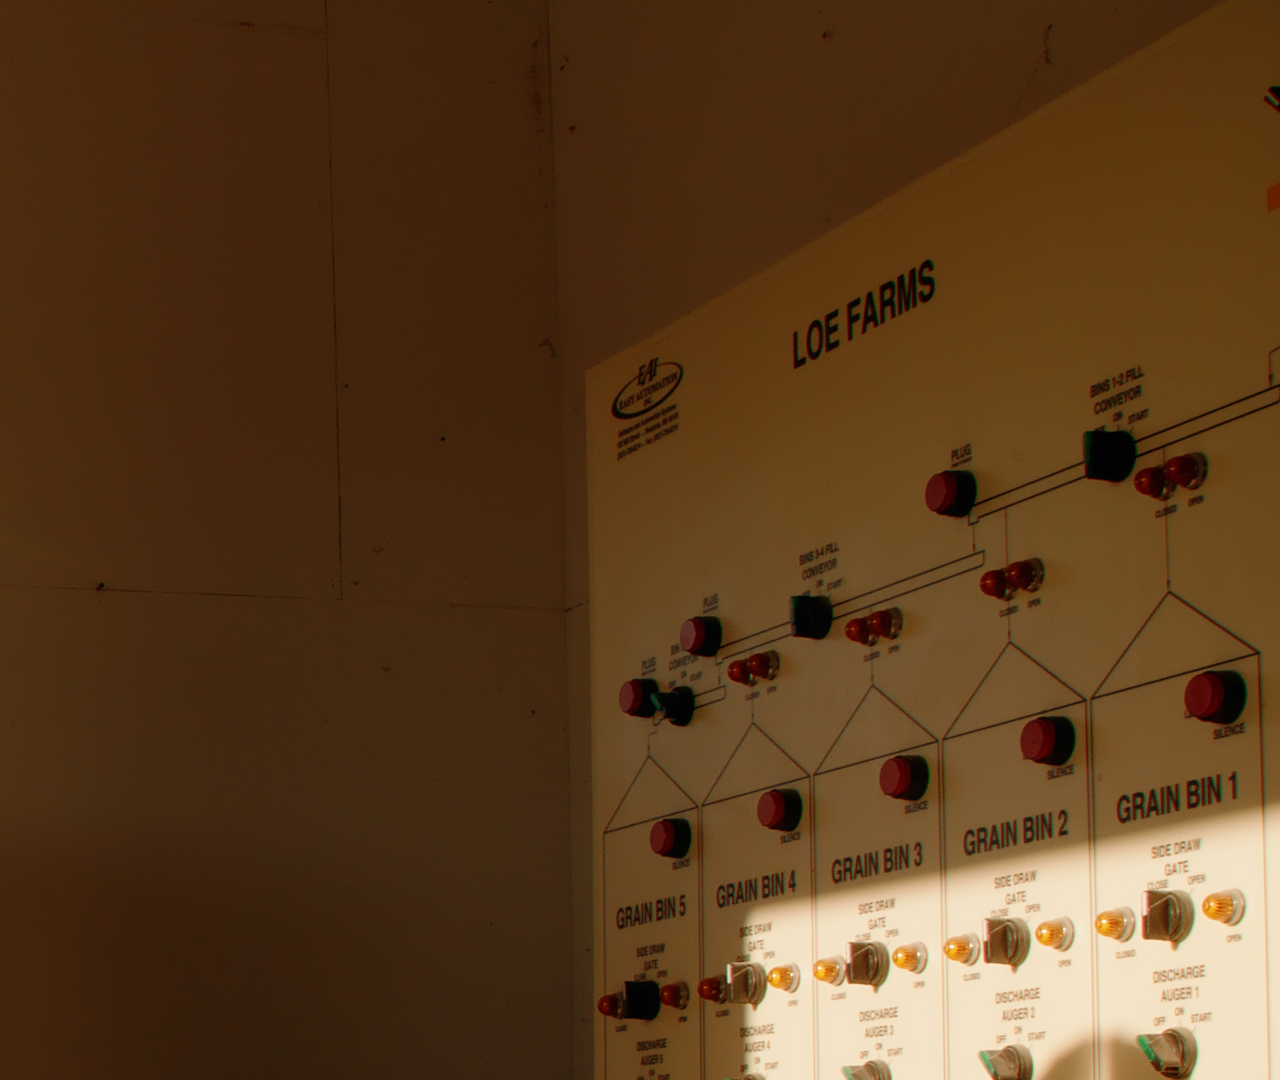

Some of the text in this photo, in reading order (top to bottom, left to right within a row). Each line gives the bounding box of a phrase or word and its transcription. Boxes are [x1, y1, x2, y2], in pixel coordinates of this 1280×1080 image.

[793, 259, 936, 370] LOE FARMS
[1090, 365, 1144, 398] BINS 1-2 FILL
[1094, 384, 1142, 414] CONVEYOR
[1128, 408, 1148, 425] START
[951, 444, 972, 462] PLUG
[1188, 494, 1204, 508] OPEN
[1154, 504, 1178, 519] CLOSED
[799, 542, 840, 566] BINS 3-4 FILL
[802, 558, 838, 581] CONVEYOR
[702, 593, 718, 608] PLUG
[1027, 598, 1041, 608] OPEN
[999, 606, 1019, 618] CLOSED
[641, 656, 656, 671] PLUG
[1213, 722, 1245, 740] SILENCE
[1047, 764, 1074, 780] SILENCE
[1116, 771, 1238, 824] GRAIN BIN 1
[904, 800, 928, 814] SILENCE
[780, 832, 802, 844] SILENCE
[964, 808, 1070, 856] GRAIN BIN 2
[1151, 838, 1201, 859] SIDE DRAW
[672, 858, 691, 871] SILENCE
[831, 842, 924, 884] GRAIN BIN 3
[1164, 860, 1189, 876] GATE
[994, 870, 1037, 889] SIDE DRAW
[1147, 880, 1168, 890] CLOSE
[1187, 874, 1206, 885] OPEN
[716, 870, 797, 908] GRAIN BIN 4
[1005, 890, 1026, 905] GATE
[616, 894, 686, 930] GRAIN BIN 5
[858, 898, 896, 915] SIDE DRAW
[1024, 904, 1040, 914] OPEN
[740, 922, 772, 938] SIDE DRAW
[868, 916, 886, 930] GATE
[884, 928, 899, 938] OPEN
[1226, 934, 1242, 943] OPEN
[636, 943, 666, 958] SIDE DRAW
[748, 939, 765, 952] GATE
[762, 951, 775, 960] OPEN
[1116, 950, 1136, 959] CLOSED
[644, 959, 658, 971] GATE
[1058, 959, 1072, 968] OPEN
[962, 972, 981, 982] CLOSED
[1152, 965, 1206, 983] DISCHARGE
[913, 981, 926, 989] OPEN
[830, 992, 847, 1000] CLOSED
[995, 987, 1040, 1004] DISCHARGE
[1161, 986, 1200, 1002] AUGER 1
[859, 1007, 898, 1022] DISCHARGE
[1002, 1006, 1036, 1022] AUGER 2
[1174, 1006, 1185, 1016] ON
[1190, 1012, 1212, 1023] START
[1154, 1016, 1166, 1026] OFF
[740, 1024, 775, 1038] DISCHARGE
[864, 1024, 894, 1038] AUGER 3
[1014, 1026, 1022, 1034] ON
[1027, 1031, 1046, 1041] START
[636, 1038, 667, 1052] DISCHARGE
[996, 1034, 1006, 1044] OFF
[744, 1040, 771, 1054] AUGER 4
[874, 1042, 882, 1051] ON
[887, 1048, 903, 1057] START
[640, 1055, 658, 1066] AUGER
[859, 1050, 869, 1059] OFF
[740, 1064, 748, 1072] OFF
[764, 1062, 778, 1070] START
